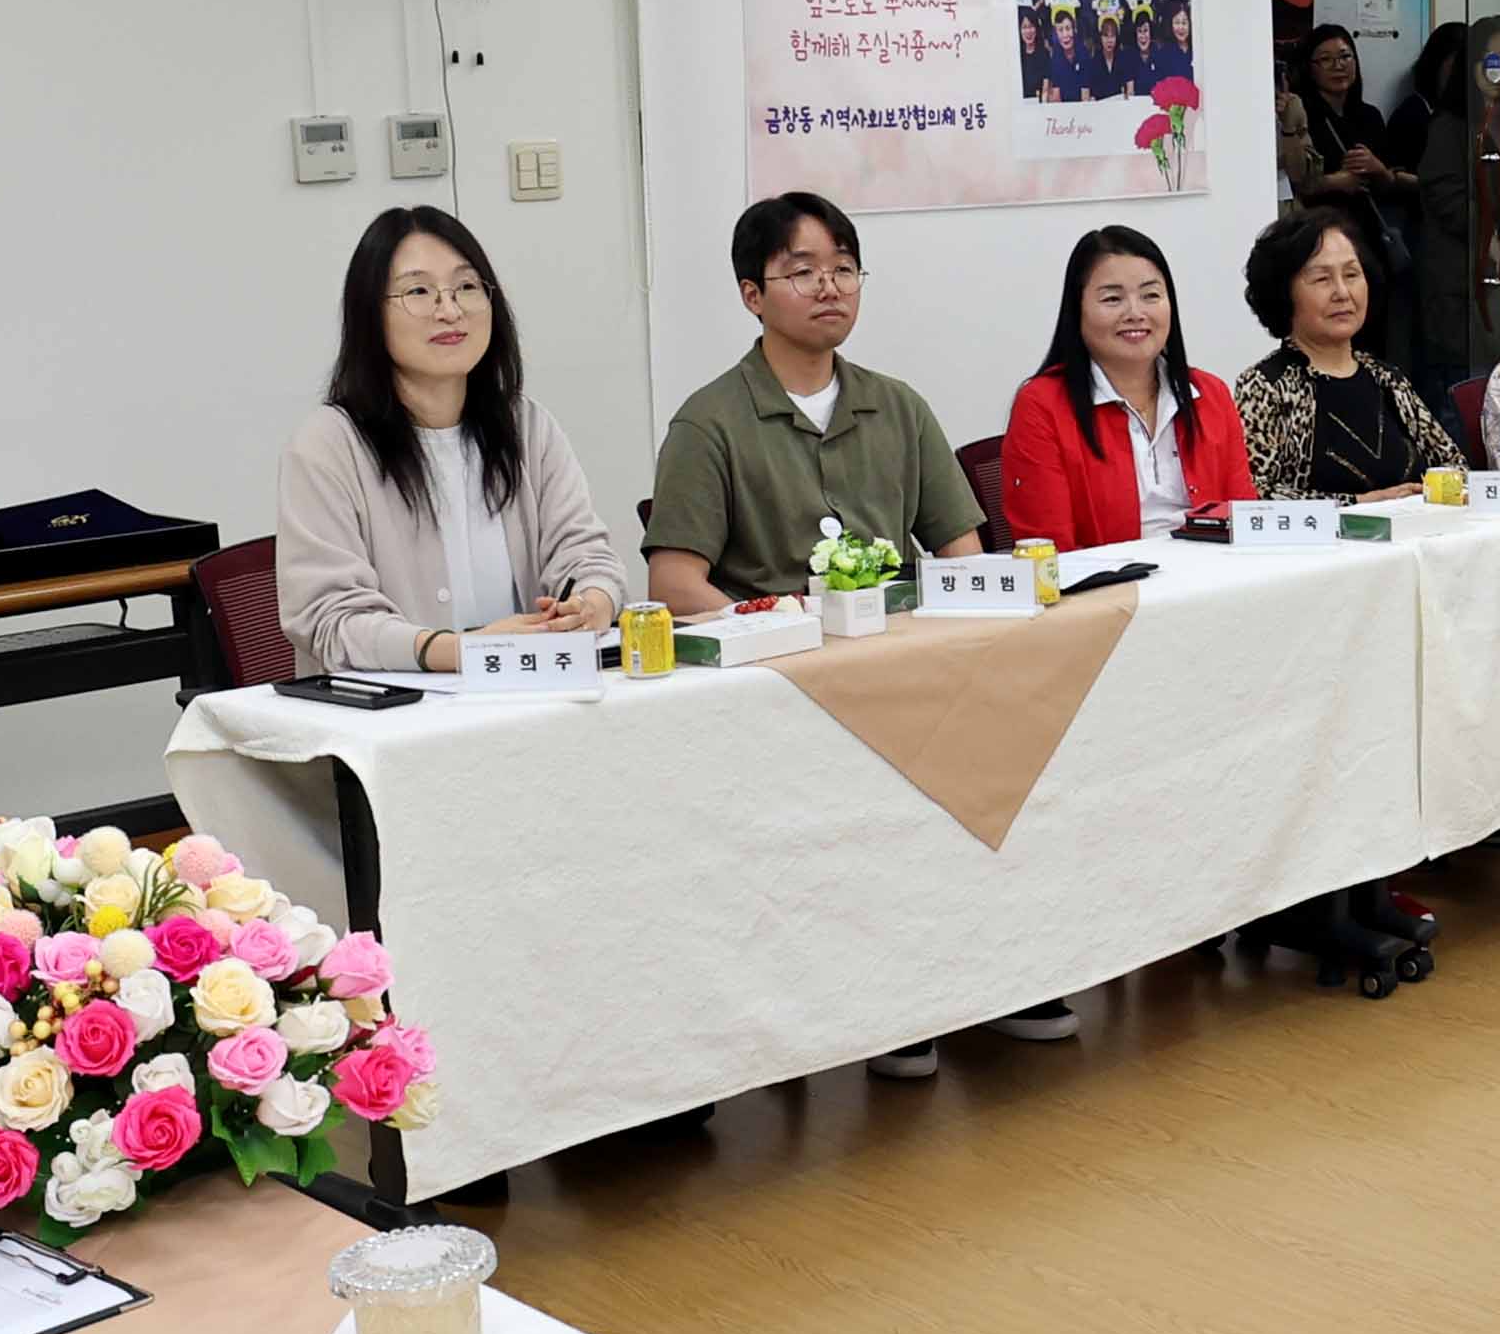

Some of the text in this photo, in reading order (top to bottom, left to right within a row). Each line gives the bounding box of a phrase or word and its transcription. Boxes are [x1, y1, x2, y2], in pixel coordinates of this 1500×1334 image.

[790, 30, 850, 61] 함께해
[765, 102, 988, 135] 금창동 지역사회보장협의체 일동
[1046, 117, 1075, 136] Thank
[941, 575, 1015, 592] 방희범
[484, 652, 573, 673] 홍희주
